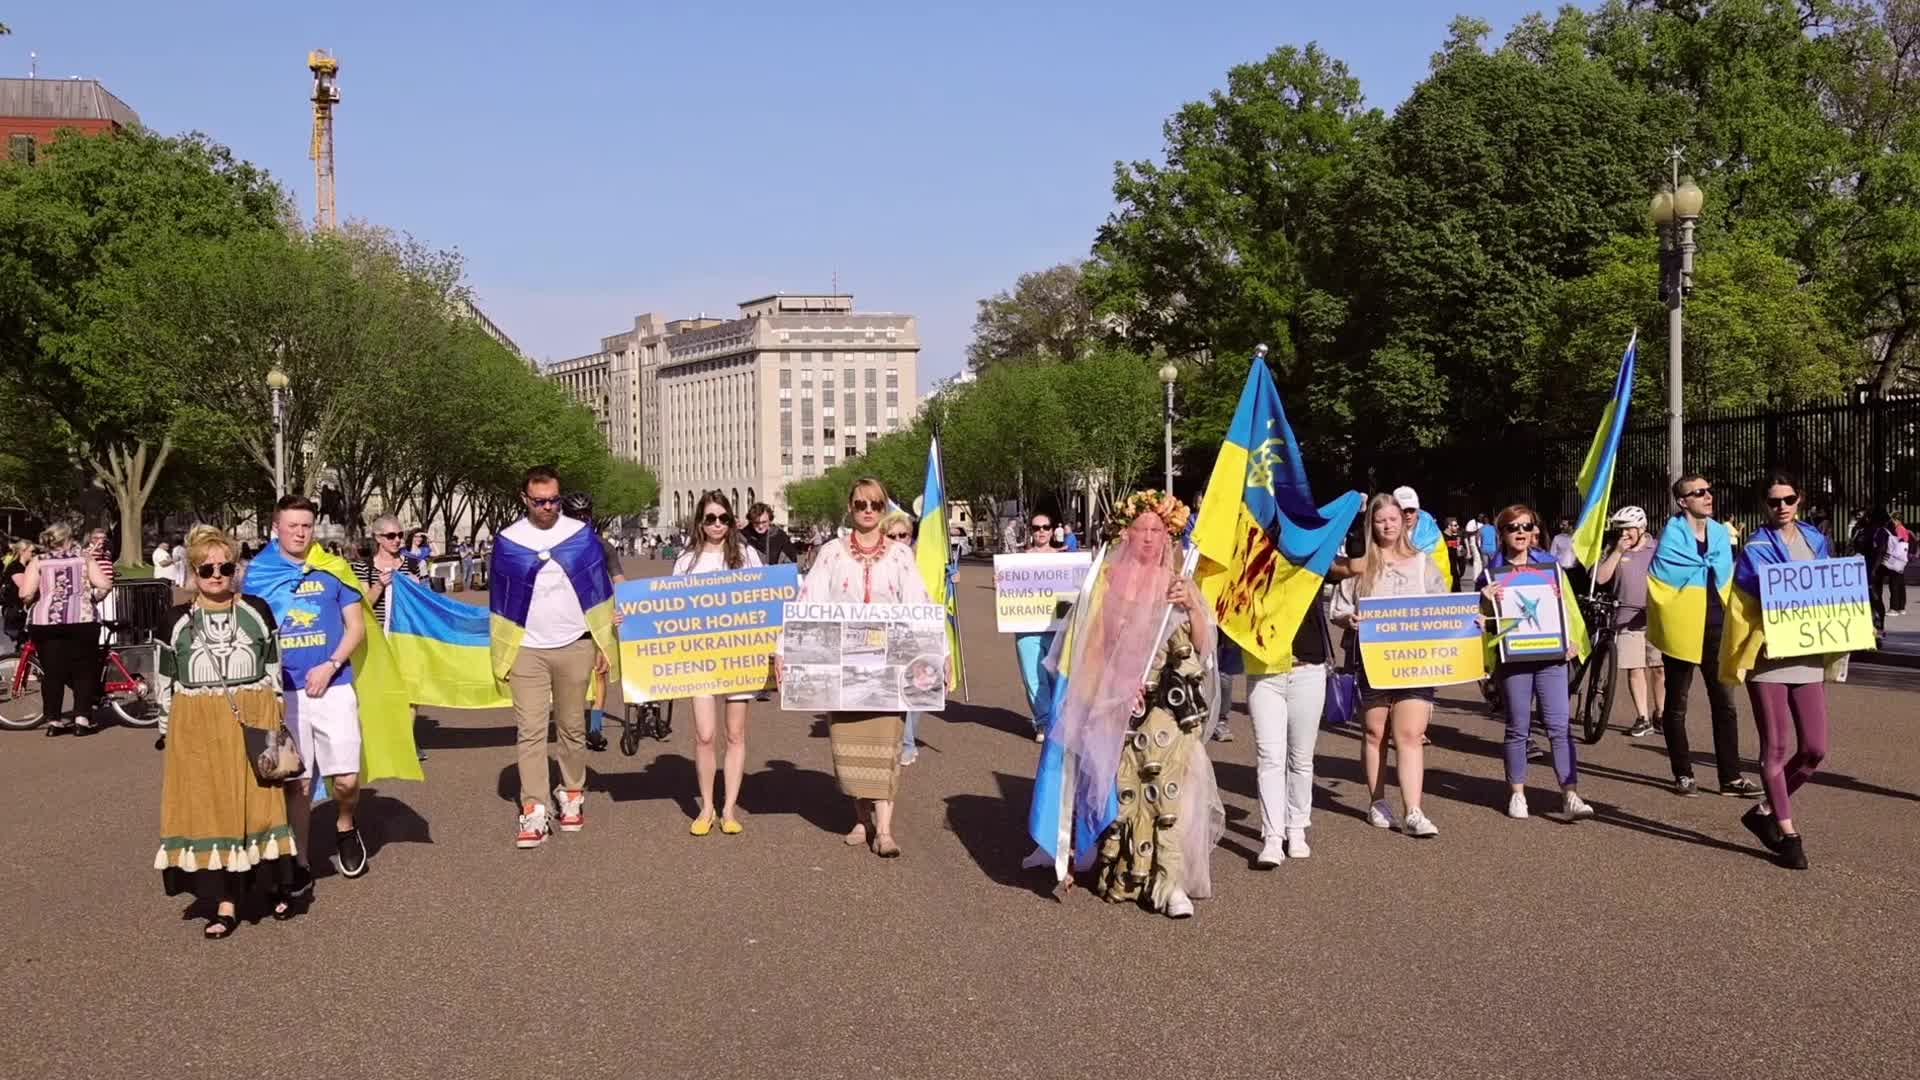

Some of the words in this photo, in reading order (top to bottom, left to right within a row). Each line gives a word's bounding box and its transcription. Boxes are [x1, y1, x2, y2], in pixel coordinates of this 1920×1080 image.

[650, 572, 762, 591] #ArmUkraineNow
[998, 570, 1030, 581] SEND
[1767, 562, 1864, 595] PROTECT
[620, 597, 685, 615] WOULD
[688, 592, 727, 609] YOU
[731, 586, 795, 604] DEFEND
[1000, 588, 1034, 598] ARMS
[1036, 587, 1053, 598] TO
[785, 604, 845, 619] BUCHA
[850, 604, 944, 620] MASSACRE
[1000, 605, 1052, 616] UKRAINE
[1360, 608, 1408, 619] UKRAINE
[1410, 607, 1420, 617] IS
[1422, 605, 1479, 616] STANDING
[1766, 595, 1865, 624] UKRAINIAN
[653, 617, 702, 634] YOUR
[706, 610, 767, 629] HOME?
[1375, 622, 1398, 632] FOR
[1400, 622, 1418, 631] THE
[1421, 620, 1462, 631] WORLD
[1799, 618, 1851, 648] SKY
[636, 641, 676, 657] HELP
[681, 630, 783, 652] UKRAINIAN
[1383, 648, 1427, 661] STAND
[1431, 647, 1458, 657] FOR
[652, 659, 716, 677] DEFEND
[1391, 664, 1454, 678] UKRAINE
